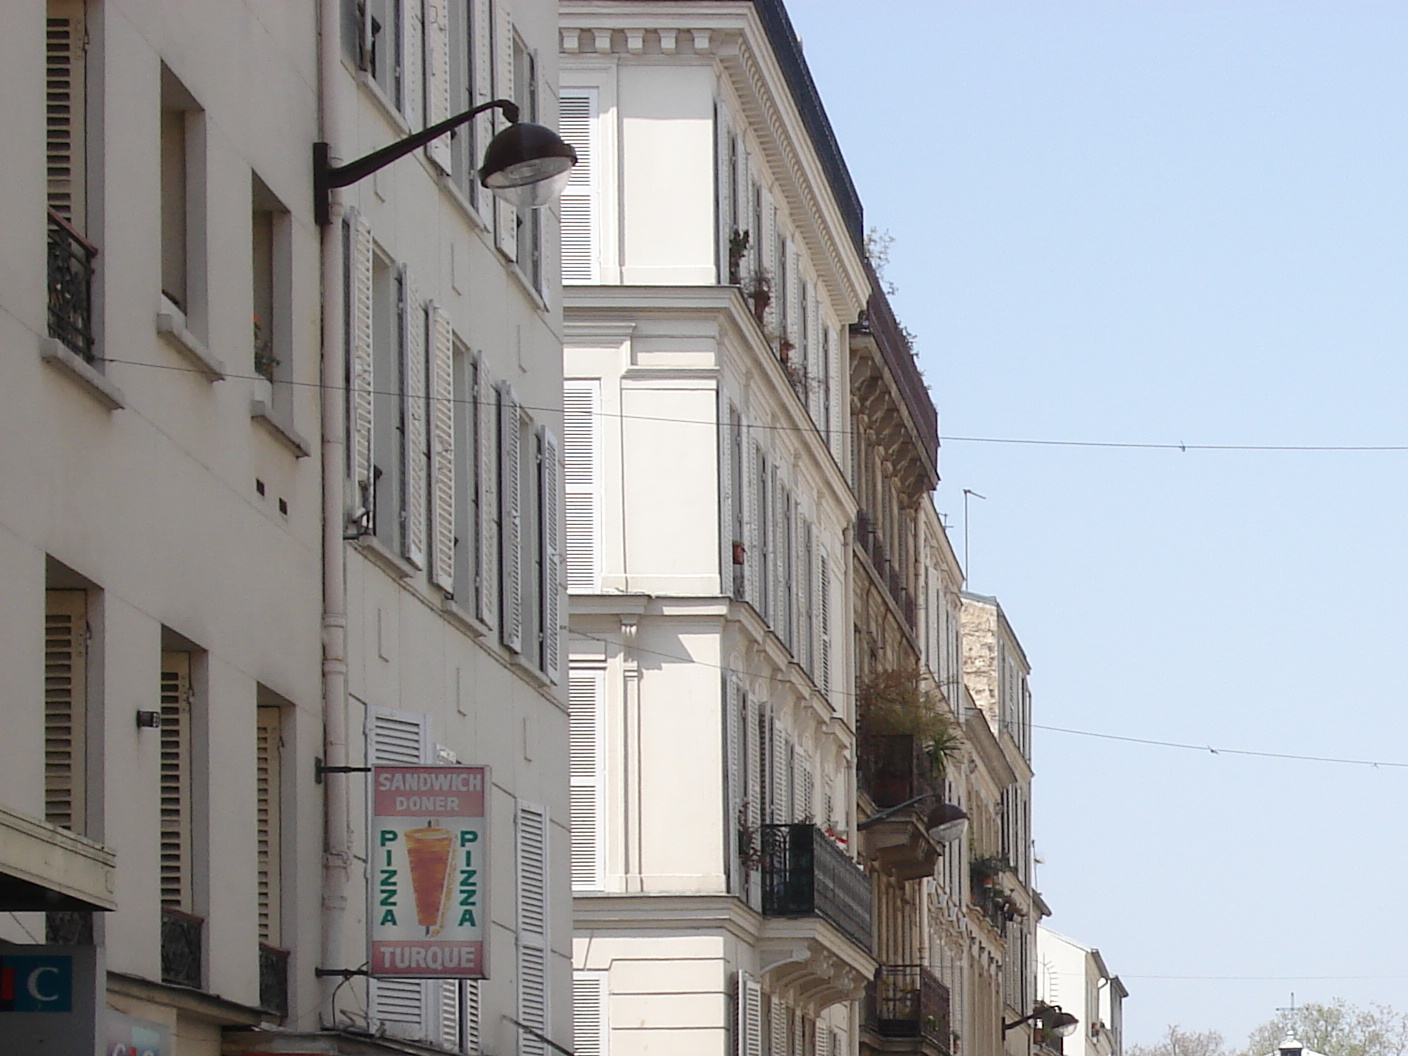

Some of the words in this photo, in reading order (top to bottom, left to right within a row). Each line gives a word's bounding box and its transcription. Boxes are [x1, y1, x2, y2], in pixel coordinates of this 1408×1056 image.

[378, 773, 482, 791] SANDWICH
[395, 797, 459, 811] DONER
[380, 830, 398, 926] PIZZA
[458, 830, 478, 927] PIZZA
[380, 947, 475, 970] TURQUE
